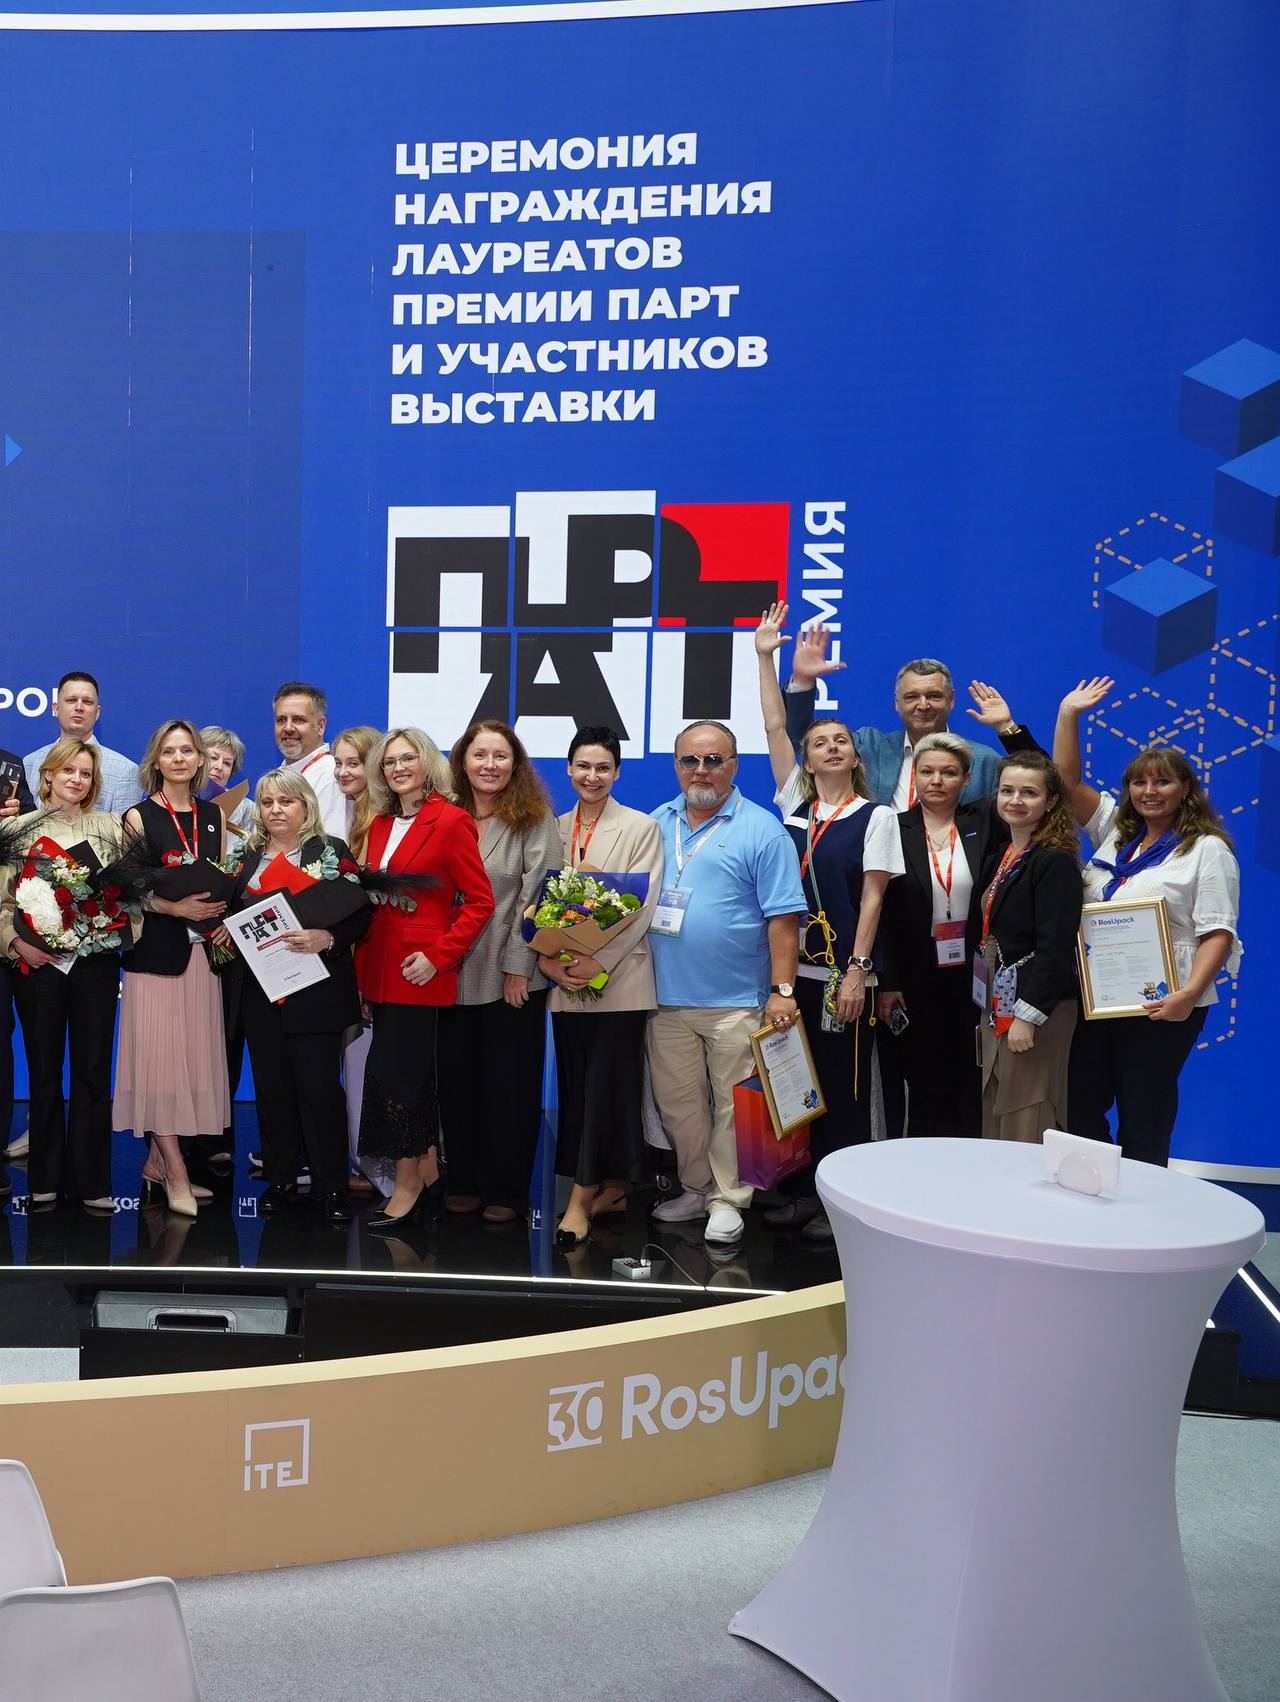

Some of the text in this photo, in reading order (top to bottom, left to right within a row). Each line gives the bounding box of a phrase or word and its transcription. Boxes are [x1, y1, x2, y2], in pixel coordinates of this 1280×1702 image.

[395, 133, 697, 179] ЦЕРЕМОНИЯ
[394, 181, 772, 225] НАГРАЖДЕНИЯ
[392, 237, 683, 276] ЛАУРЕАТОВ
[392, 286, 740, 325] ПРЕМИИ ПАРТ
[392, 336, 768, 375] И УЧАСТНИКОВ
[391, 389, 656, 425] ВЫСТАВКИ
[621, 1351, 847, 1440] RosUpa
